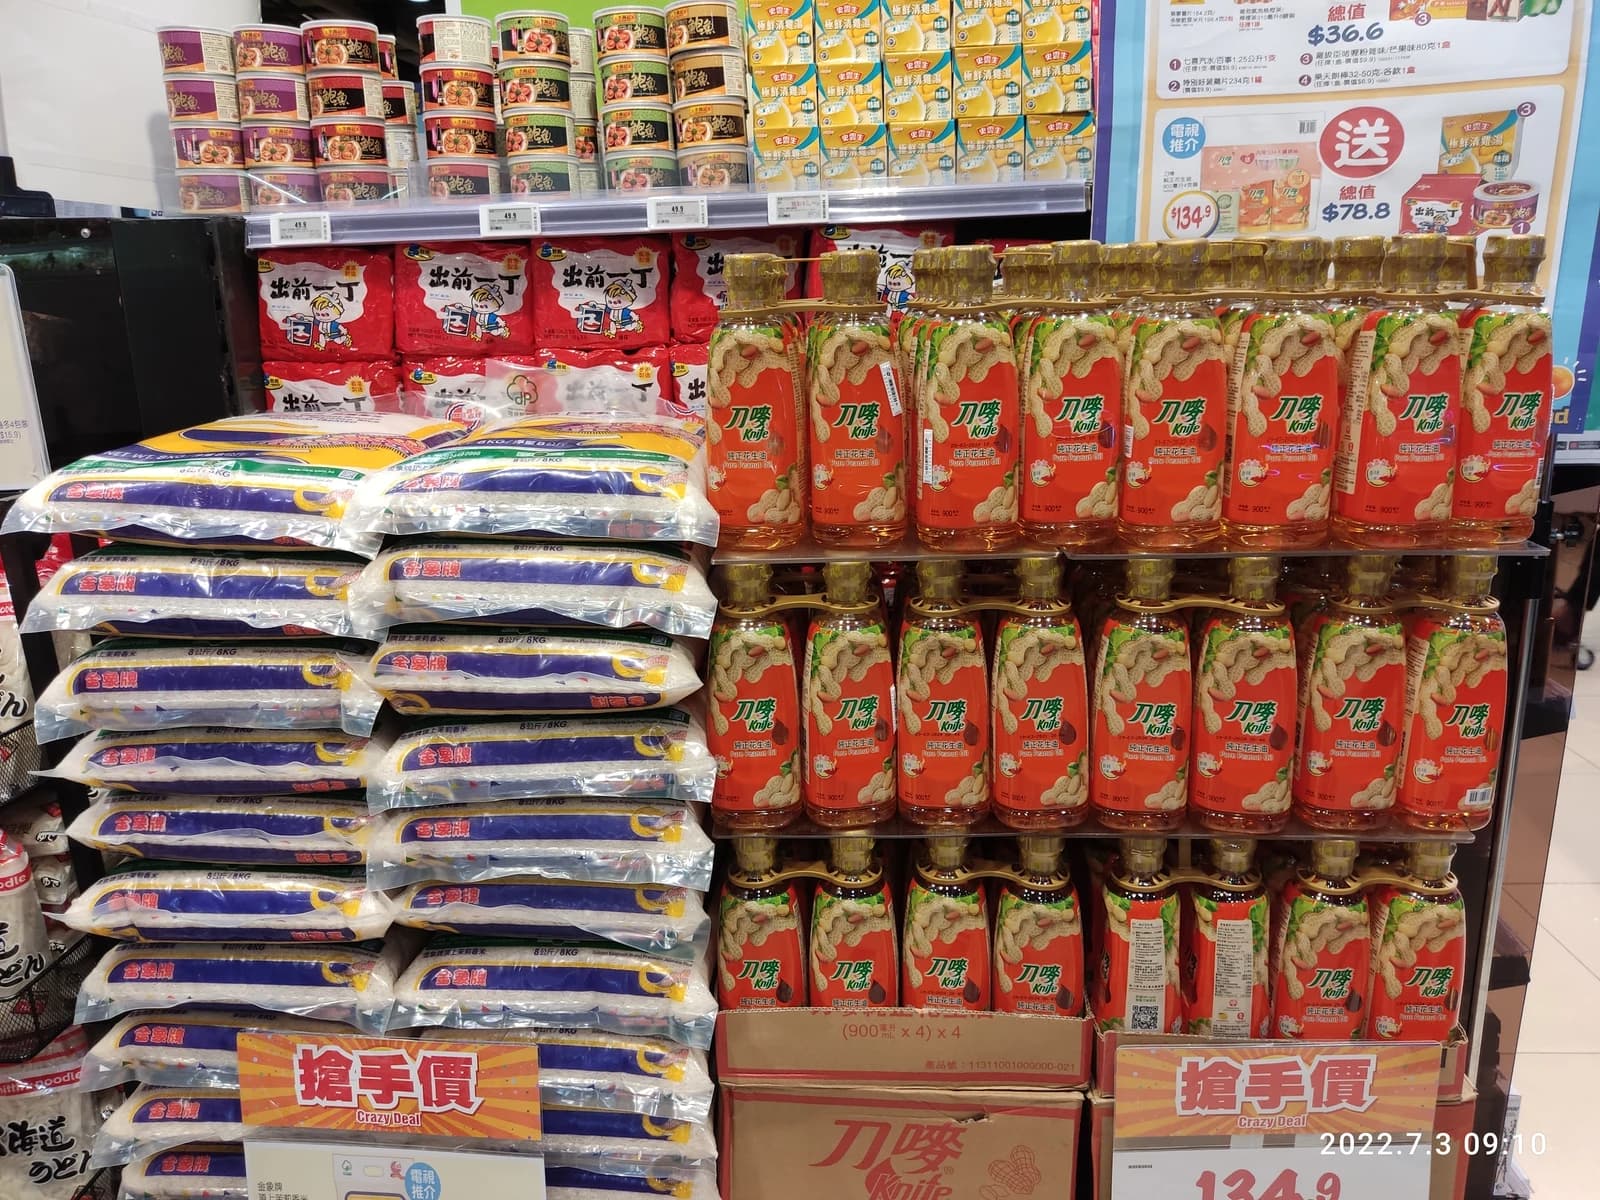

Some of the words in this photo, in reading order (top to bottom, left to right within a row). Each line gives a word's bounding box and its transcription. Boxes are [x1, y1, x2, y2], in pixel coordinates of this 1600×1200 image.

[1328, 4, 1366, 21] 總值
[1308, 22, 1384, 46] $36.6
[1170, 124, 1200, 138] 電視
[1170, 138, 1198, 152] 推介
[1334, 118, 1391, 168] 送
[1340, 185, 1376, 200] 總值
[1322, 202, 1390, 222] $78.8
[1415, 206, 1458, 218] 出前一丁
[428, 266, 520, 294] 出前一丁
[562, 264, 653, 288] 出前一丁
[270, 276, 360, 302] 出前一丁
[953, 399, 999, 425] 刀嘜
[1056, 396, 1103, 421] 刀嘜
[1154, 398, 1205, 424] 刀嘜
[1271, 394, 1321, 421] 刀嘜
[1400, 393, 1448, 419] 刀嘜
[1494, 392, 1540, 416] 刀嘜
[725, 402, 771, 429] 刀嘜
[835, 402, 880, 428] 刀嘜
[1510, 415, 1536, 430] Knife
[850, 426, 876, 440] Knife
[970, 425, 998, 438] Knife
[1073, 420, 1100, 434] Knife
[1170, 422, 1200, 436] Knife
[1288, 419, 1317, 433] Knife
[1416, 418, 1444, 432] Knife
[742, 428, 769, 441] Knife
[403, 560, 461, 578] 金象牌
[79, 575, 136, 592] 金象牌
[393, 655, 448, 672] 金象牌
[84, 671, 138, 689] 金象牌
[732, 698, 775, 721] 刀嘜
[835, 695, 878, 720] 刀嘜
[924, 699, 966, 721] 刀嘜
[1021, 698, 1063, 720] 刀嘜
[1128, 703, 1176, 724] 刀嘜
[1225, 700, 1276, 722] 刀嘜
[1335, 698, 1384, 719] 刀嘜
[1446, 704, 1489, 726] 刀嘜
[748, 720, 772, 732] Knife
[850, 718, 876, 730] Knife
[940, 720, 964, 732] Knife
[1036, 718, 1060, 730] Knife
[1145, 722, 1172, 736] Knife
[1243, 720, 1271, 734] Knife
[1351, 718, 1380, 731] Knife
[1461, 725, 1485, 738] Knife
[102, 748, 156, 765] 金象牌
[419, 747, 472, 766] 金象牌
[115, 815, 166, 832] 金象牌
[416, 822, 470, 838] 金象牌
[124, 962, 176, 980] 金象牌
[740, 959, 782, 980] 刀嘜
[833, 960, 873, 981] 刀嘜
[926, 958, 968, 978] 刀嘜
[1016, 964, 1061, 985] 刀嘜
[435, 968, 488, 986] 金象牌
[753, 978, 778, 990] Knife
[846, 978, 870, 991] Knife
[940, 976, 965, 990] Knife
[1308, 968, 1352, 988] 刀嘜
[1406, 967, 1452, 987] 刀嘜
[1032, 982, 1057, 994] Knife
[1322, 986, 1349, 1000] Knife
[1422, 984, 1447, 998] Knife
[134, 1026, 186, 1044] 金象牌
[916, 1026, 932, 1041] 4)
[952, 1026, 960, 1038] 4
[296, 1044, 484, 1114] 搶手價
[1176, 1054, 1377, 1115] 搶手價
[149, 1102, 200, 1120] 金象牌
[356, 1110, 391, 1126] Crazy
[394, 1112, 422, 1126] Deal
[1237, 1114, 1276, 1130] Crazy
[1278, 1114, 1308, 1128] Deal
[809, 1120, 968, 1174] 刀嘜
[162, 1156, 211, 1172] 金象牌
[410, 1169, 434, 1184] 電視
[257, 1182, 282, 1192] 金象牌
[412, 1186, 436, 1198] 推介
